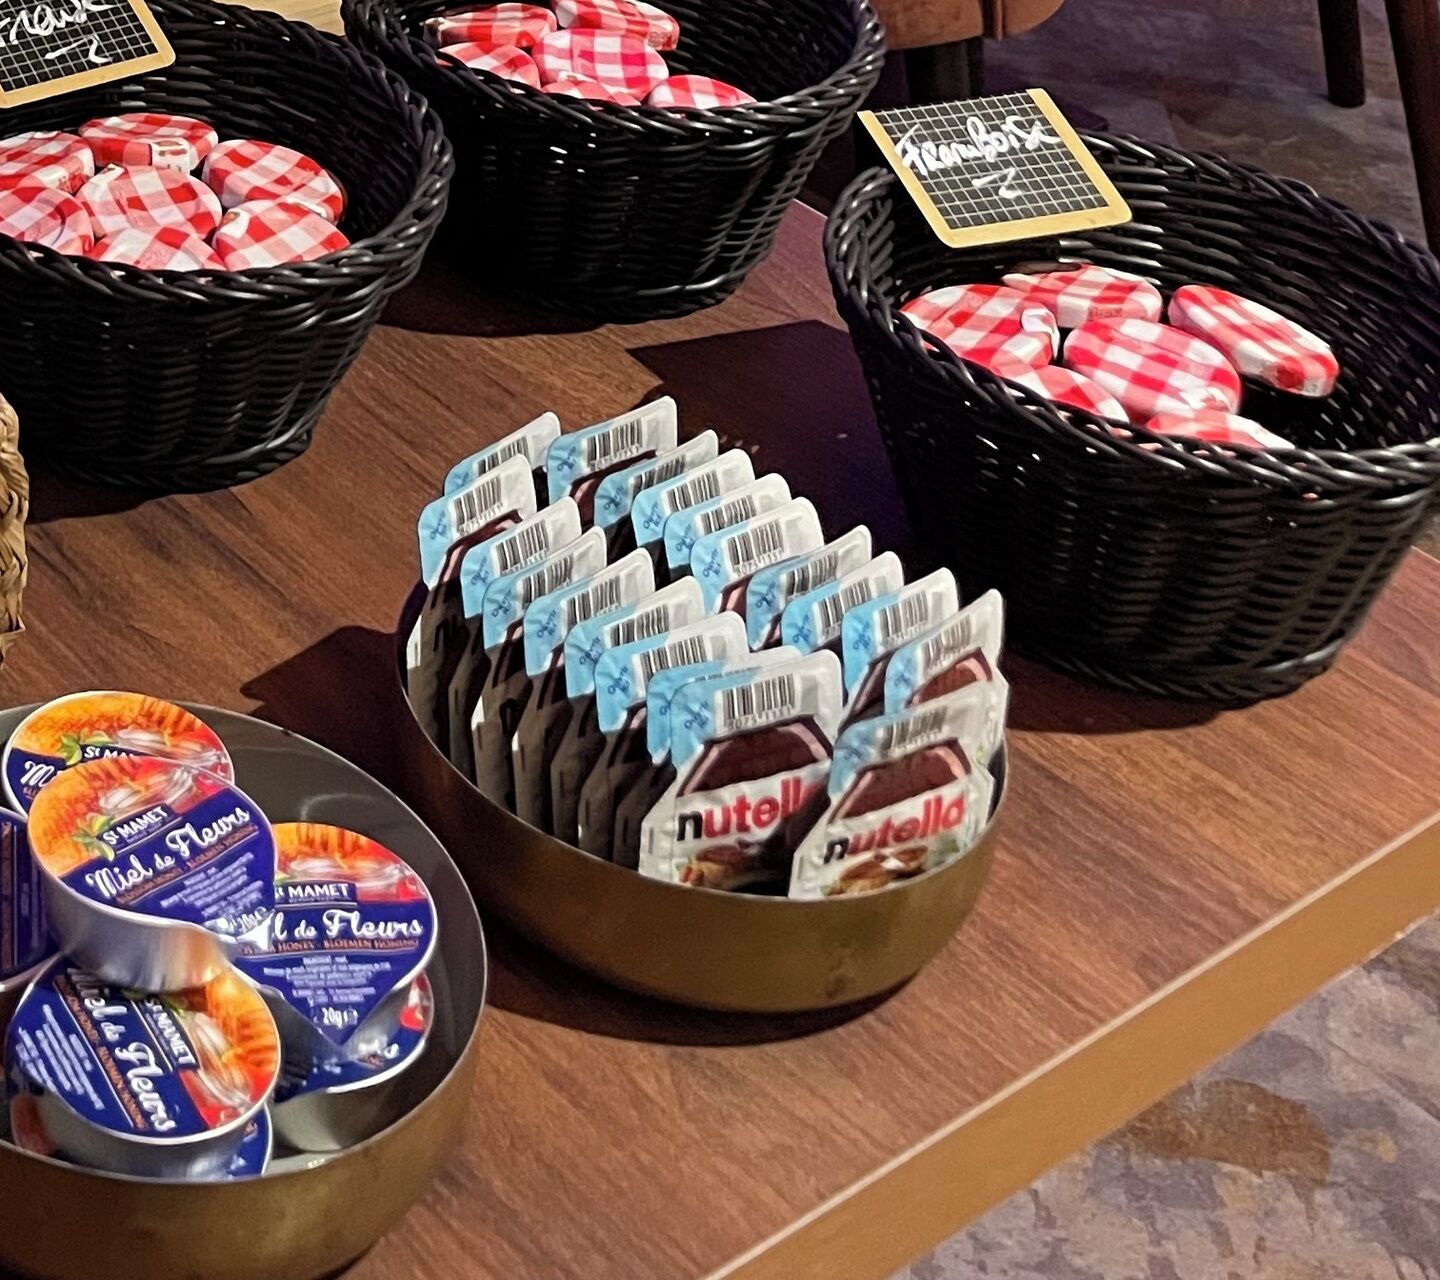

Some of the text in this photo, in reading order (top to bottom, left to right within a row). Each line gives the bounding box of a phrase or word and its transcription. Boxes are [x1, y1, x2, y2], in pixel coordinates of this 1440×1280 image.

[118, 805, 169, 840] MAMET
[822, 790, 968, 866] nutella
[84, 853, 154, 898] Miel
[152, 851, 176, 872] de
[165, 806, 251, 858] Fleurs
[288, 883, 350, 899] MAMET
[293, 919, 318, 938] de
[321, 908, 424, 939] Fleurs
[157, 1009, 197, 1065] MAMET
[113, 1040, 178, 1133] Fleurs
